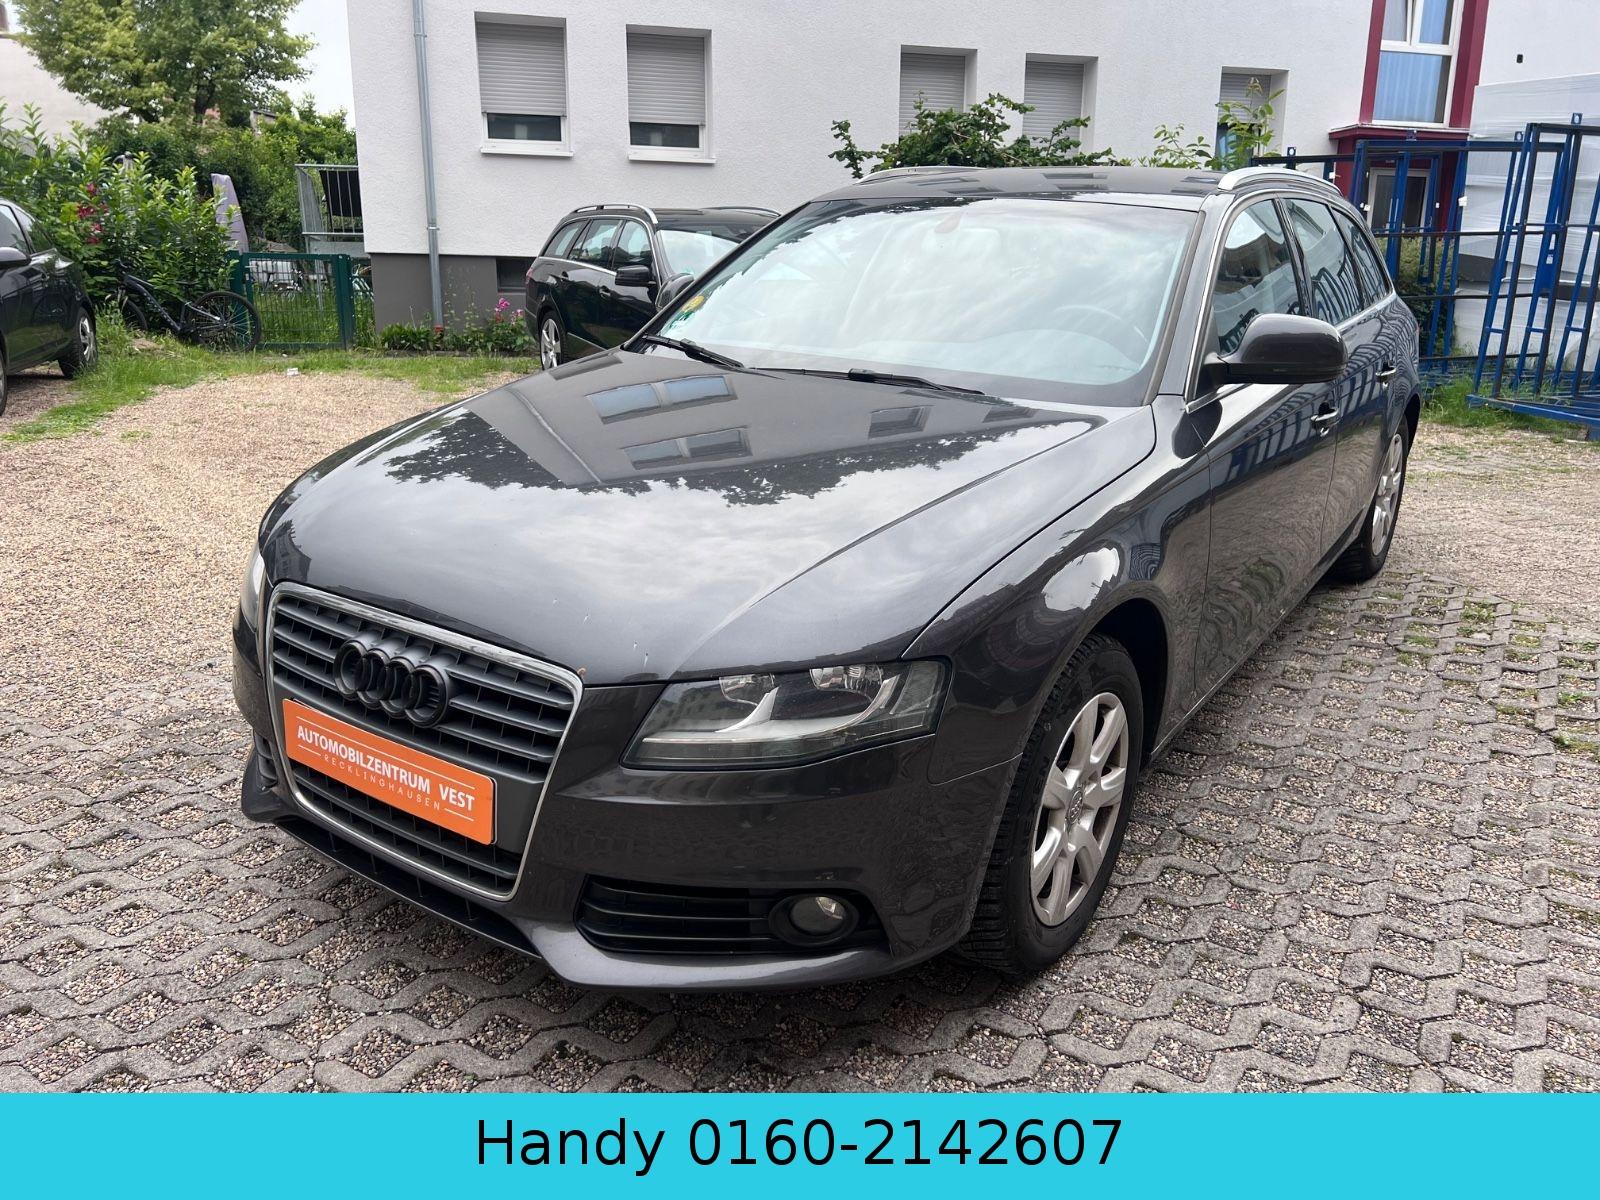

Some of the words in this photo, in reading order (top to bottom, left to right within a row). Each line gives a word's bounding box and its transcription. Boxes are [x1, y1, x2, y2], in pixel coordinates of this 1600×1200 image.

[297, 725, 431, 795] AUTOMOBILZENTRUM
[438, 783, 475, 811] VEST
[323, 754, 441, 811] RECKLINGHAUSEN
